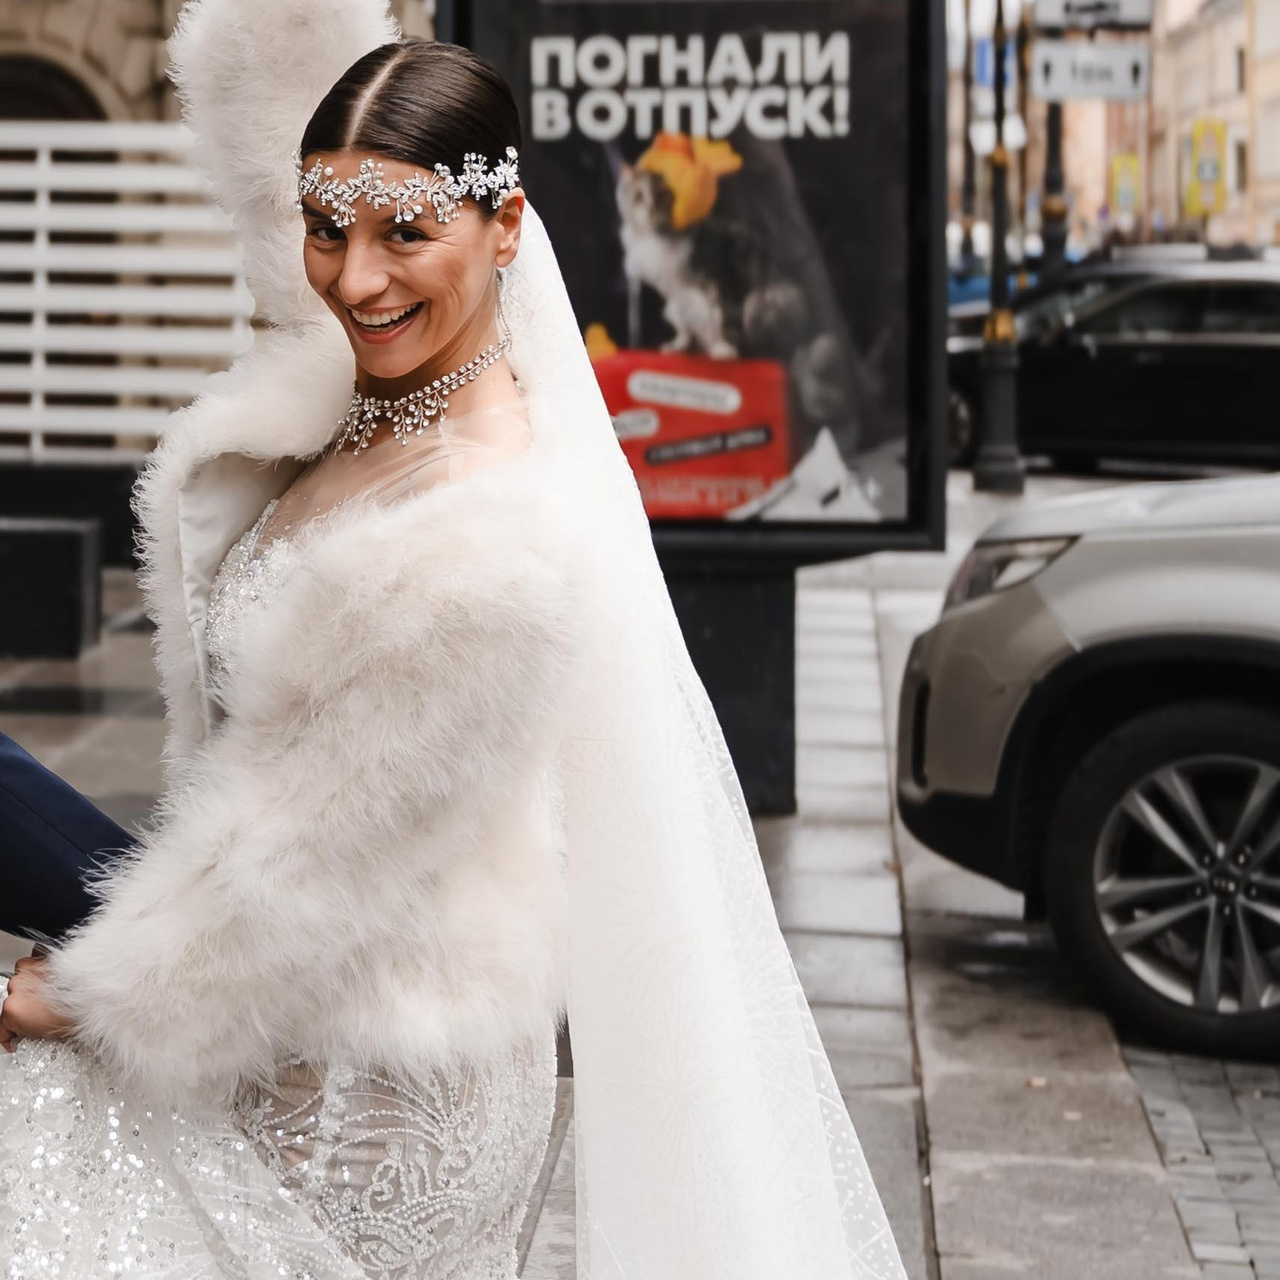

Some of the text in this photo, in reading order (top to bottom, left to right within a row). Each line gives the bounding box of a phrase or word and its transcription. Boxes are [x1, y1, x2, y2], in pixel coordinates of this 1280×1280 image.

[531, 32, 850, 87] ПОГНАЛИ
[532, 84, 850, 142] В ОТПУСК!
